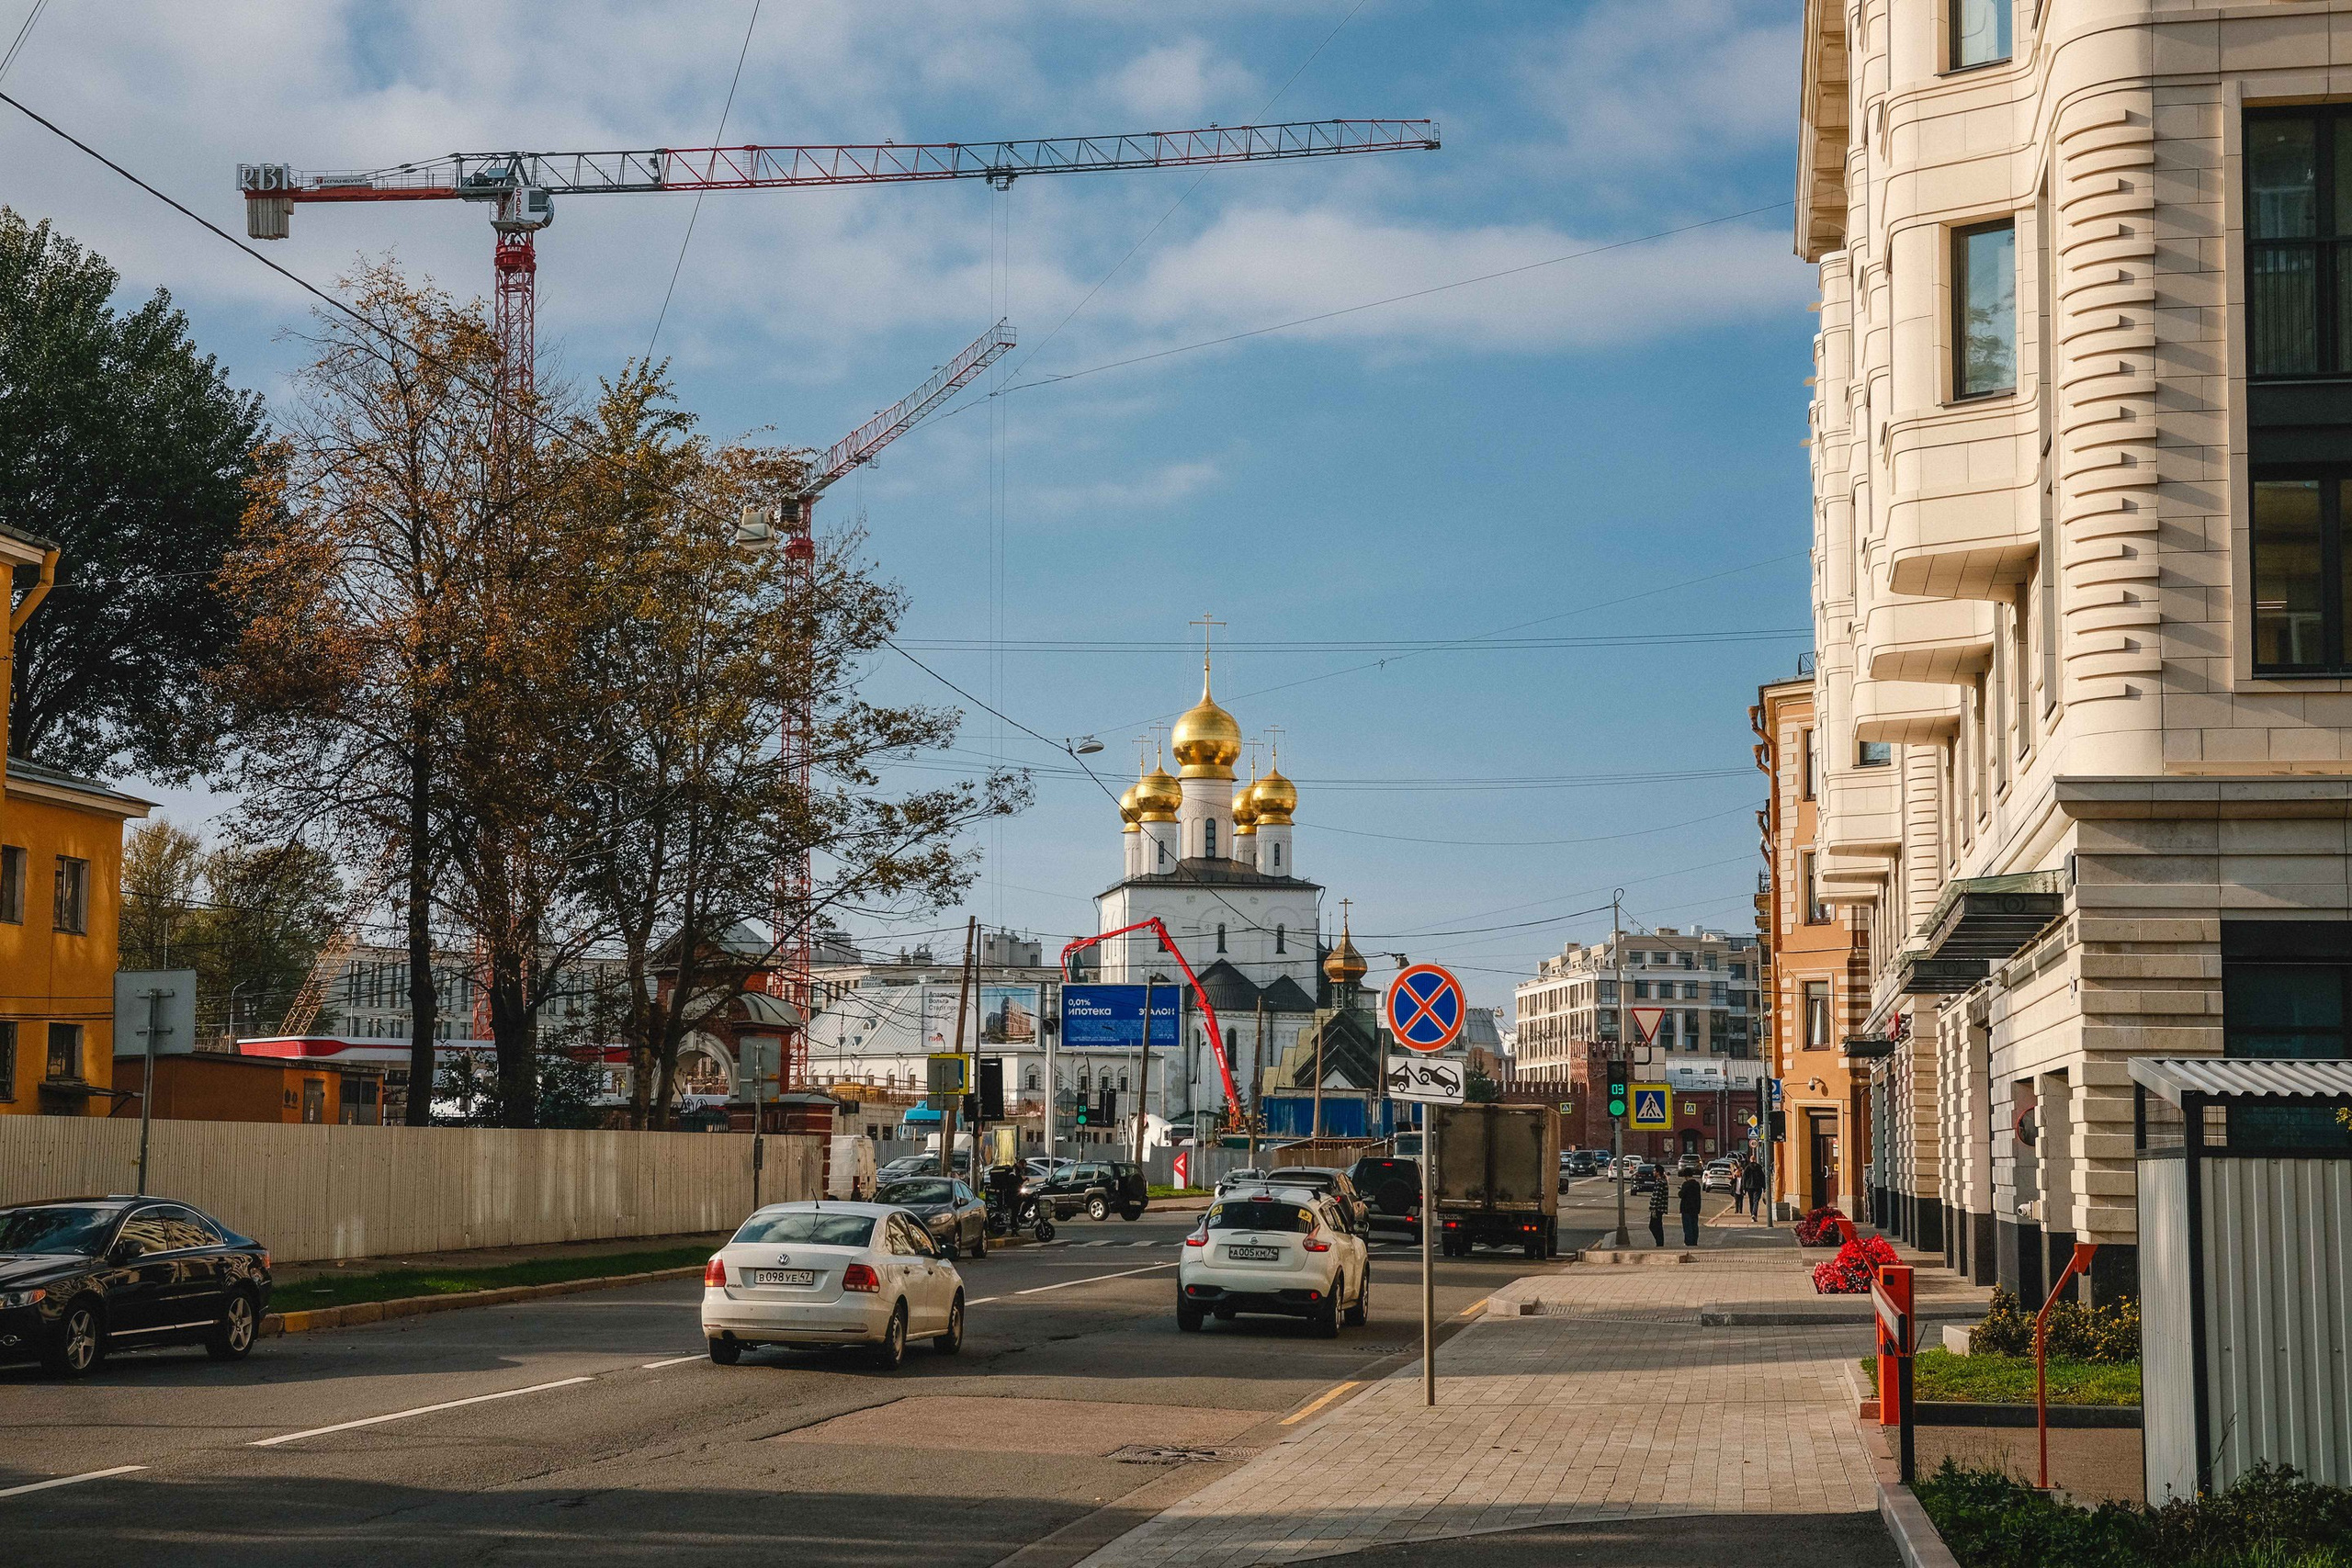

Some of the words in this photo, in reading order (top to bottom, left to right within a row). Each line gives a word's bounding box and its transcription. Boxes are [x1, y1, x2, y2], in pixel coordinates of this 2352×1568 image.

[236, 163, 289, 191] RBI
[1068, 998, 1091, 1007] 0,01%
[1068, 1008, 1112, 1016] ипотека
[1611, 1084, 1624, 1095] 03
[799, 1272, 810, 1280] 47
